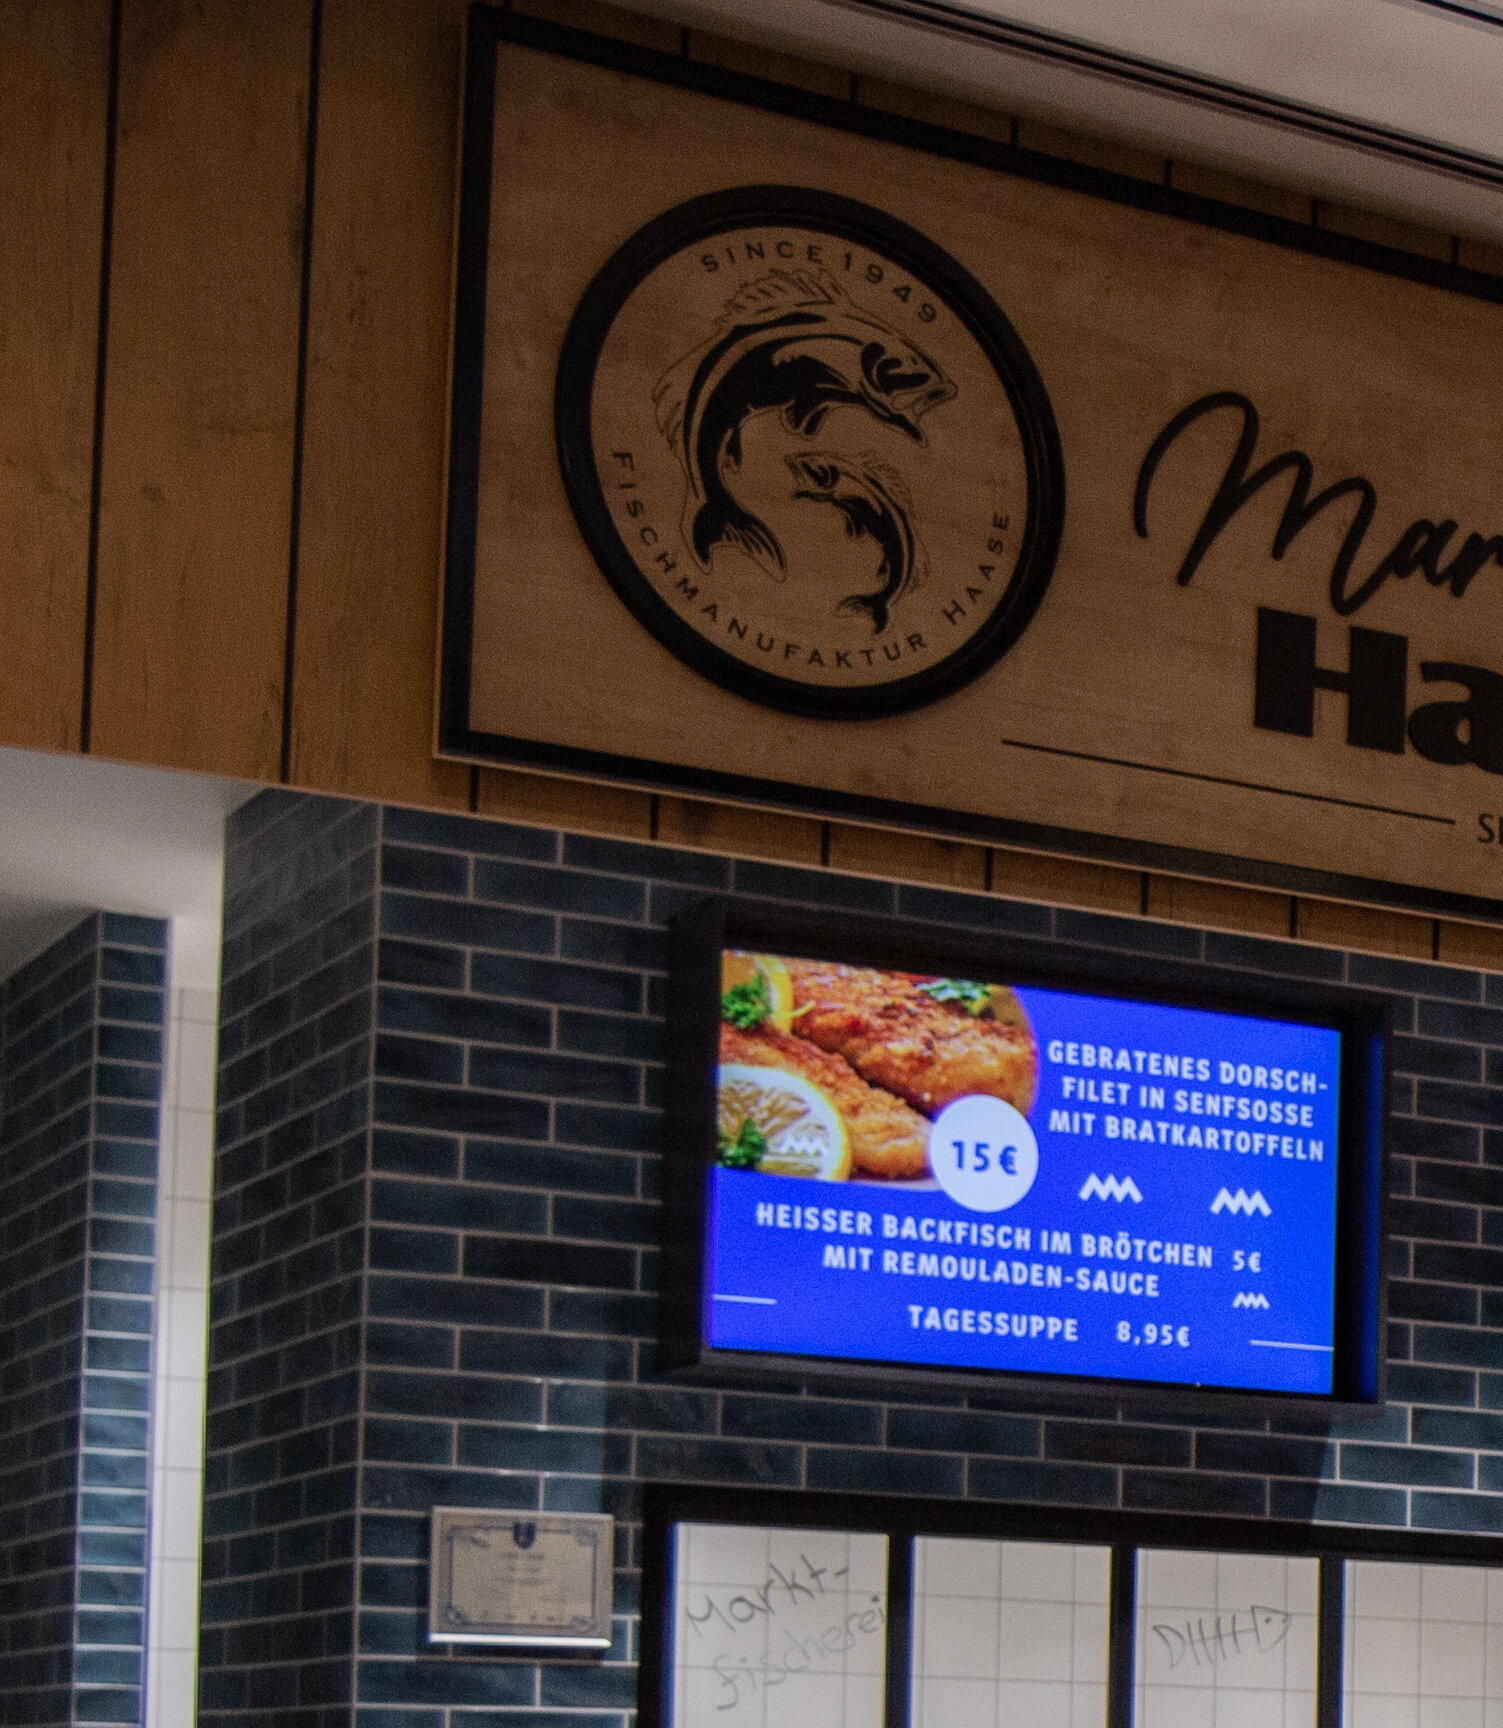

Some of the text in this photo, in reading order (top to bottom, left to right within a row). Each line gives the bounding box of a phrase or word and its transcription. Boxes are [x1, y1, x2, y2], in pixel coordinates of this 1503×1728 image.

[699, 241, 939, 325] SINCE 1949
[611, 450, 1010, 669] FISCHMANUFAKTUR HAASE
[1047, 1039, 1329, 1096] GEBRATENES DORSCH-
[1062, 1076, 1314, 1128] FILET IN SENFSOSSE
[1049, 1110, 1325, 1163] MIT BRATKARTOFFELN
[756, 1205, 874, 1237] HEISSER
[883, 1213, 1032, 1251] BACKFISCH
[1041, 1229, 1074, 1256] IM
[1082, 1231, 1213, 1269] BRÖTCHEN
[822, 1245, 1160, 1298] MIT REMOULADEN-SAUCE
[908, 1304, 1191, 1348] TAGESSUPPE 8,95€
